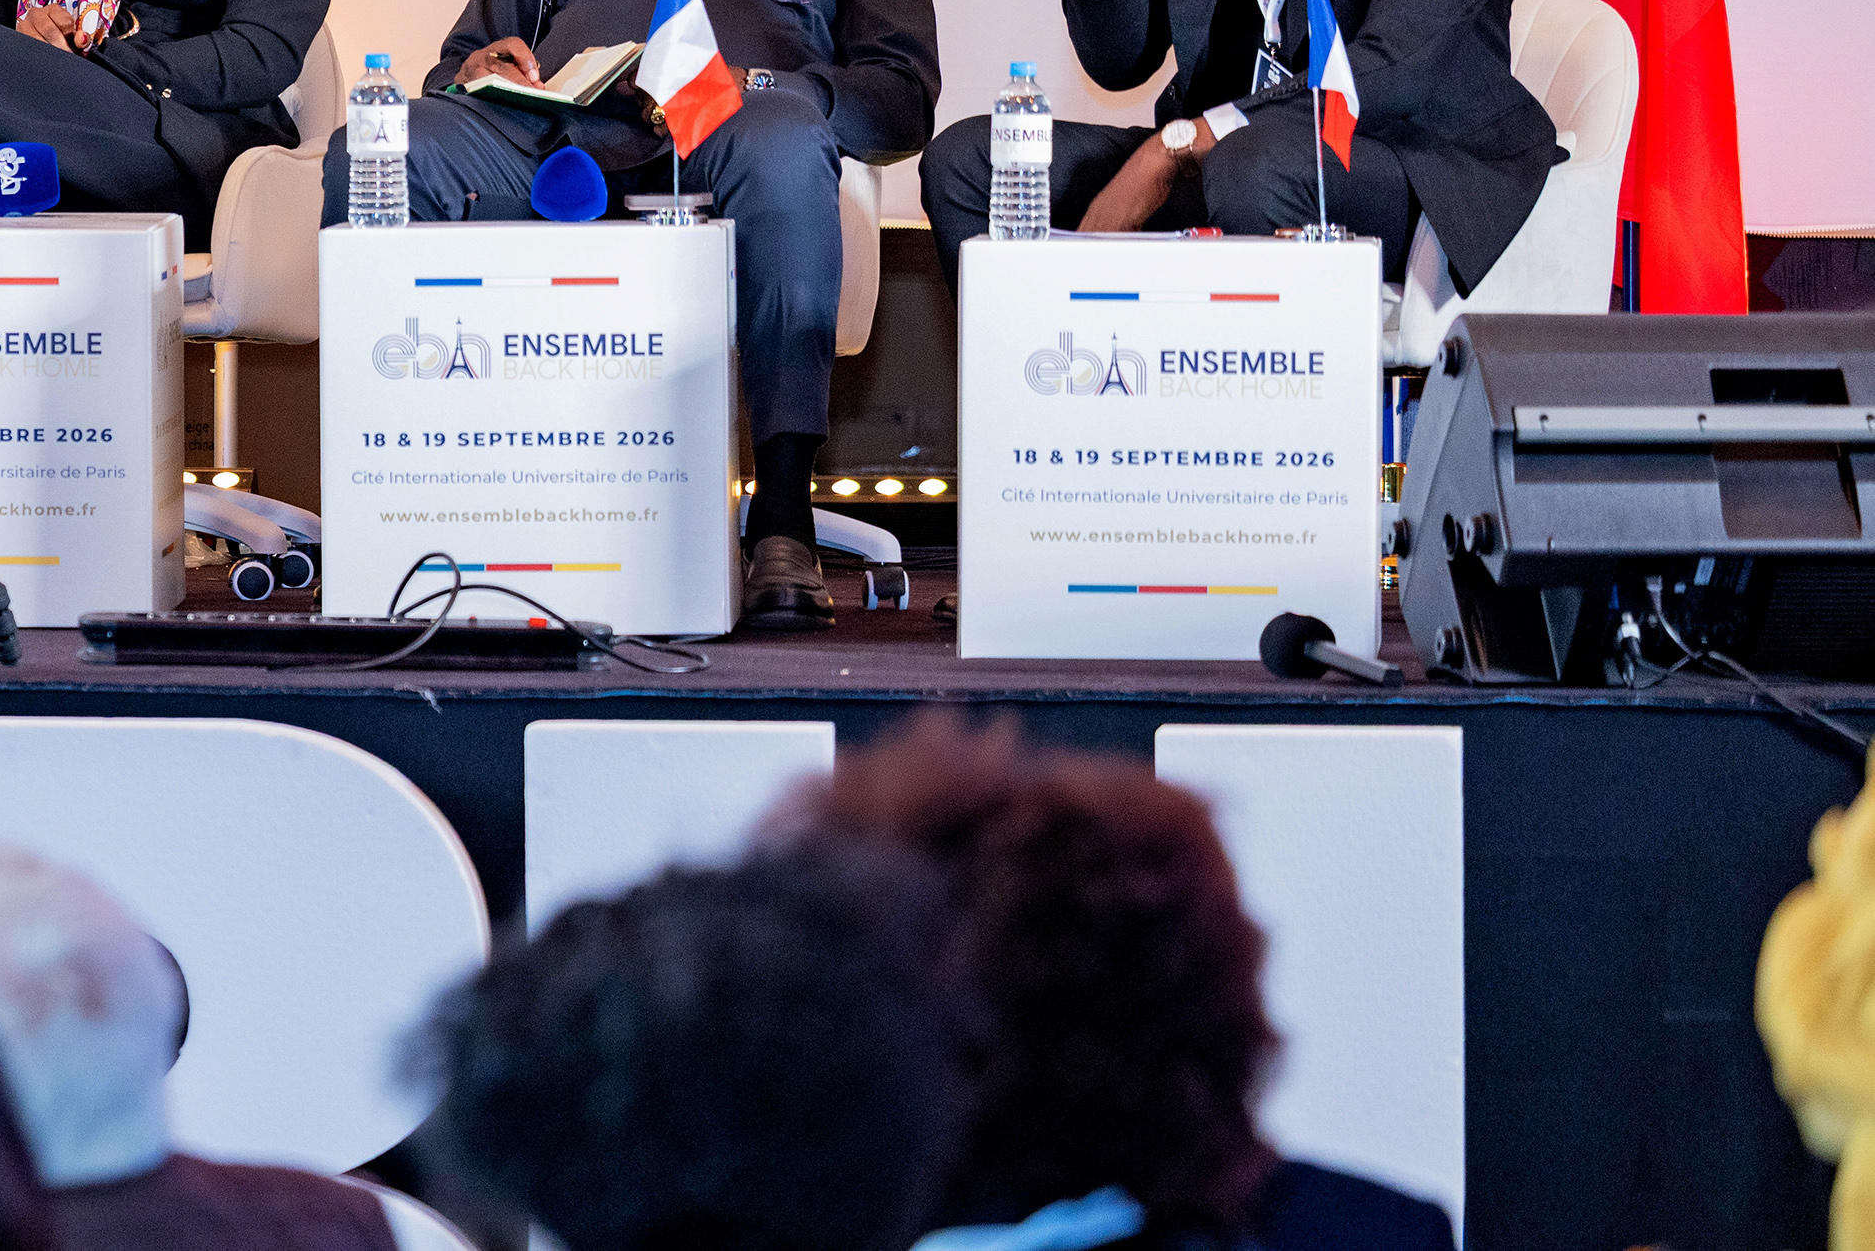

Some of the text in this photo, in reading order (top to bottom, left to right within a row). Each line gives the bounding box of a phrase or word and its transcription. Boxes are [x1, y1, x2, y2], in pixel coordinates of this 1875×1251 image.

[505, 334, 663, 356] ENSEMBLE
[1161, 351, 1323, 374] ENSEMBLE
[55, 427, 114, 443] 2026
[362, 430, 675, 448] 18 & 19 SEPTEMBRE 2026
[1014, 449, 1335, 467] 18 & 19 SEPTEMBRE 2026
[59, 464, 82, 480] de
[85, 464, 127, 480] Paris
[350, 468, 689, 485] Cité Internationale Universitaire de Paris
[1001, 488, 1349, 505] Cité Internationale Universitaire de Paris
[379, 507, 659, 523] www.ensemblebackhome.fr
[1029, 528, 1317, 545] www.ensemblebackhome.fr
